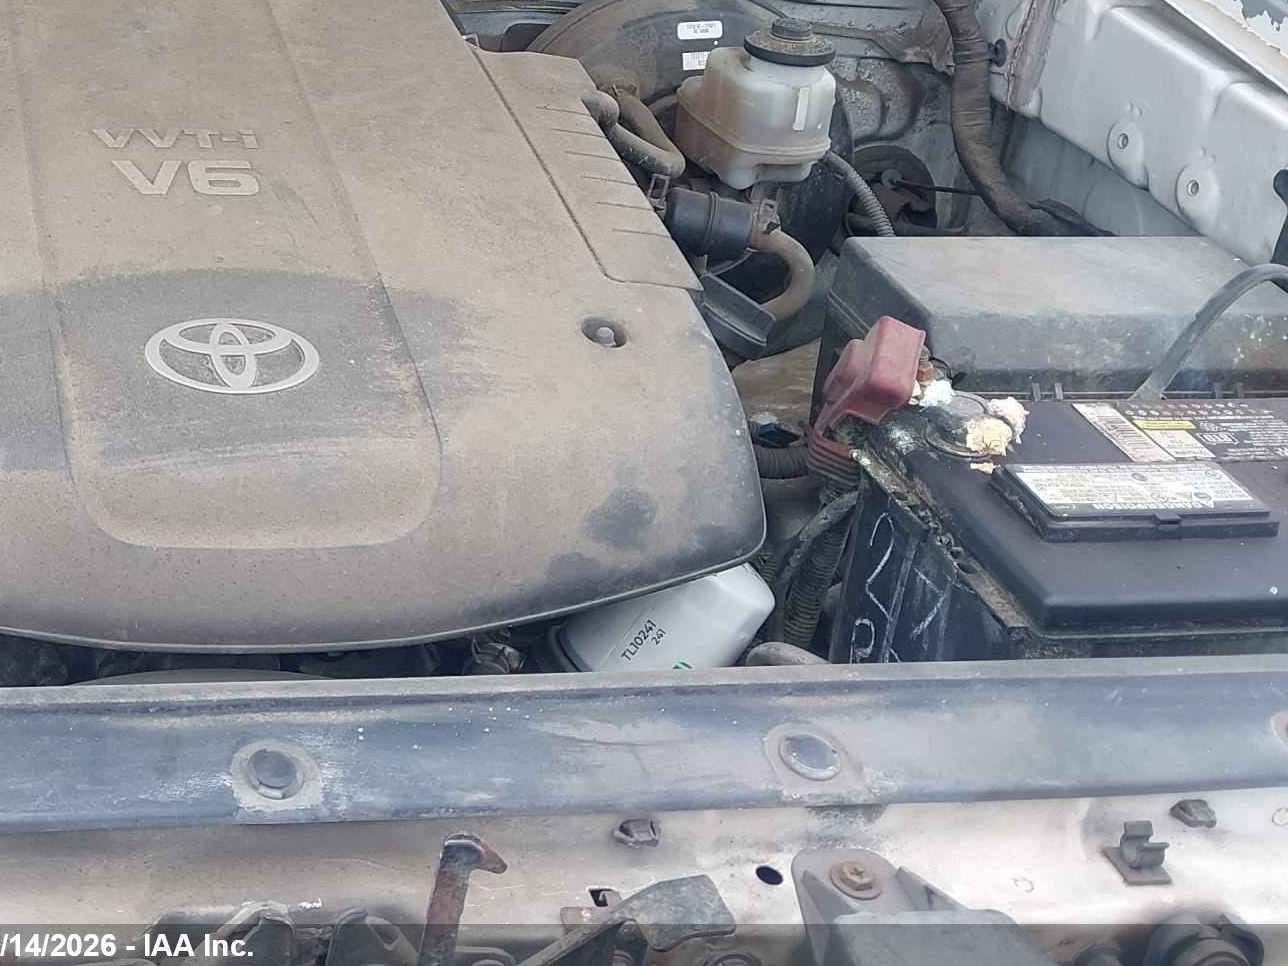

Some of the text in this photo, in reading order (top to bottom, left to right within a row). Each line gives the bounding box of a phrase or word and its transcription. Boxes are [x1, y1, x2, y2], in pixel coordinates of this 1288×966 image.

[91, 128, 259, 149] VVT-i
[111, 160, 260, 196] V6
[620, 619, 657, 661] TL10241
[651, 628, 666, 645] 241
